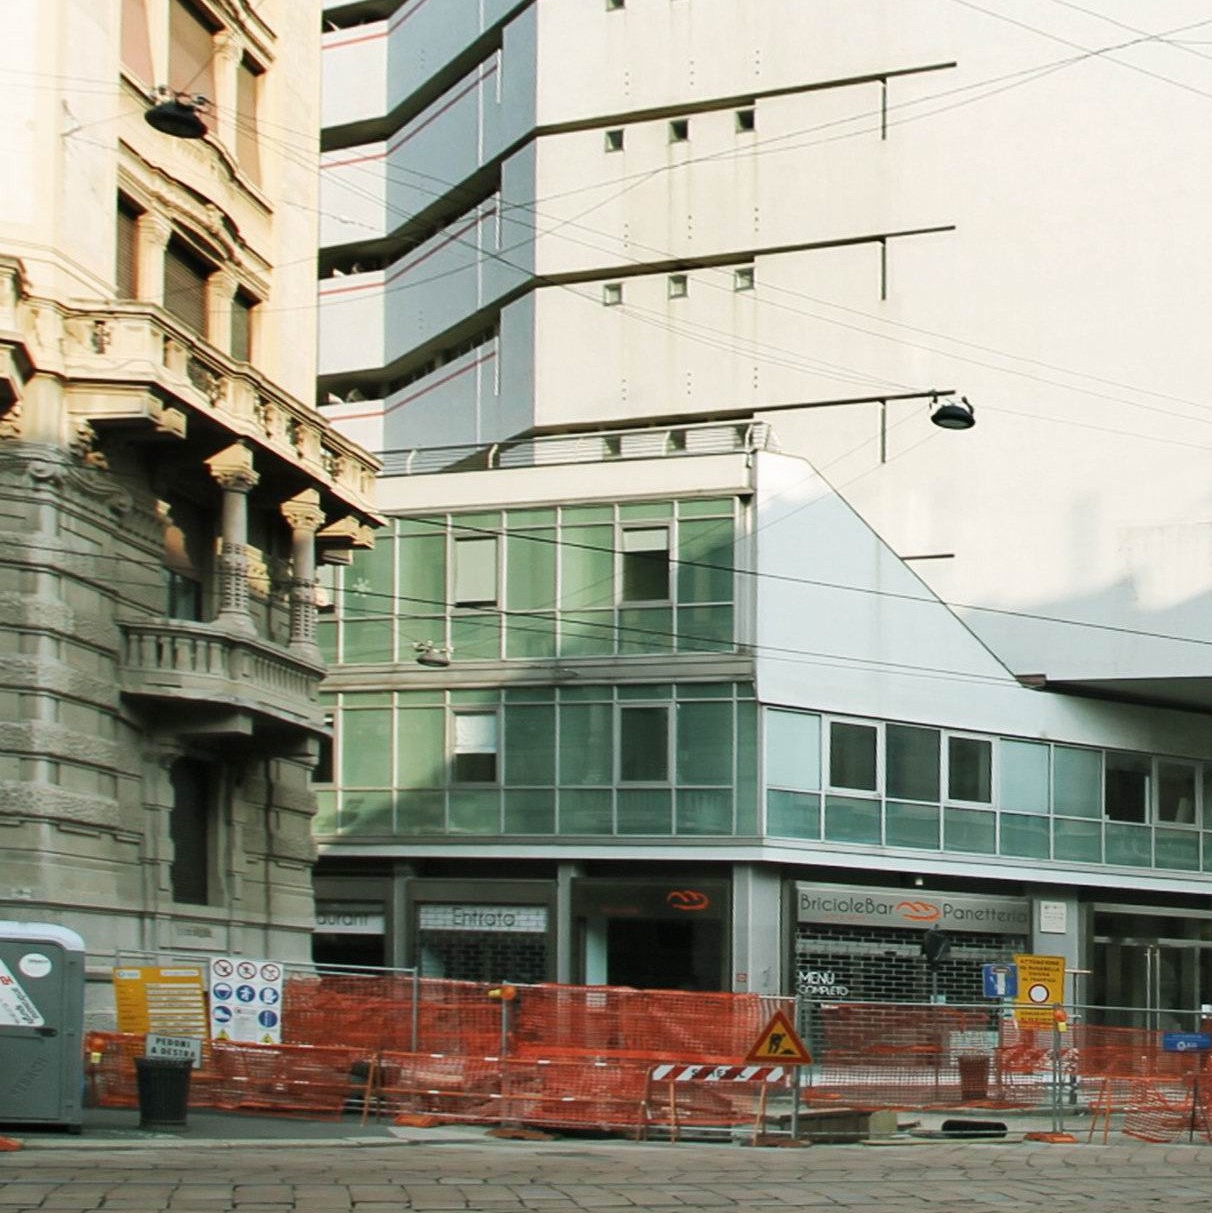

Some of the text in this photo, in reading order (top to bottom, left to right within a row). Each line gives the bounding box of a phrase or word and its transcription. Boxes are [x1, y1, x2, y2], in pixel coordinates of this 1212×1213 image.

[801, 893, 895, 916] BricioleBar
[943, 903, 1028, 924] Panetteria
[453, 906, 515, 926] Entrata
[800, 970, 836, 985] MENÙ
[800, 984, 849, 996] COMPLETO
[155, 1037, 191, 1049] PEDONI
[160, 1047, 196, 1058] DESTRA
